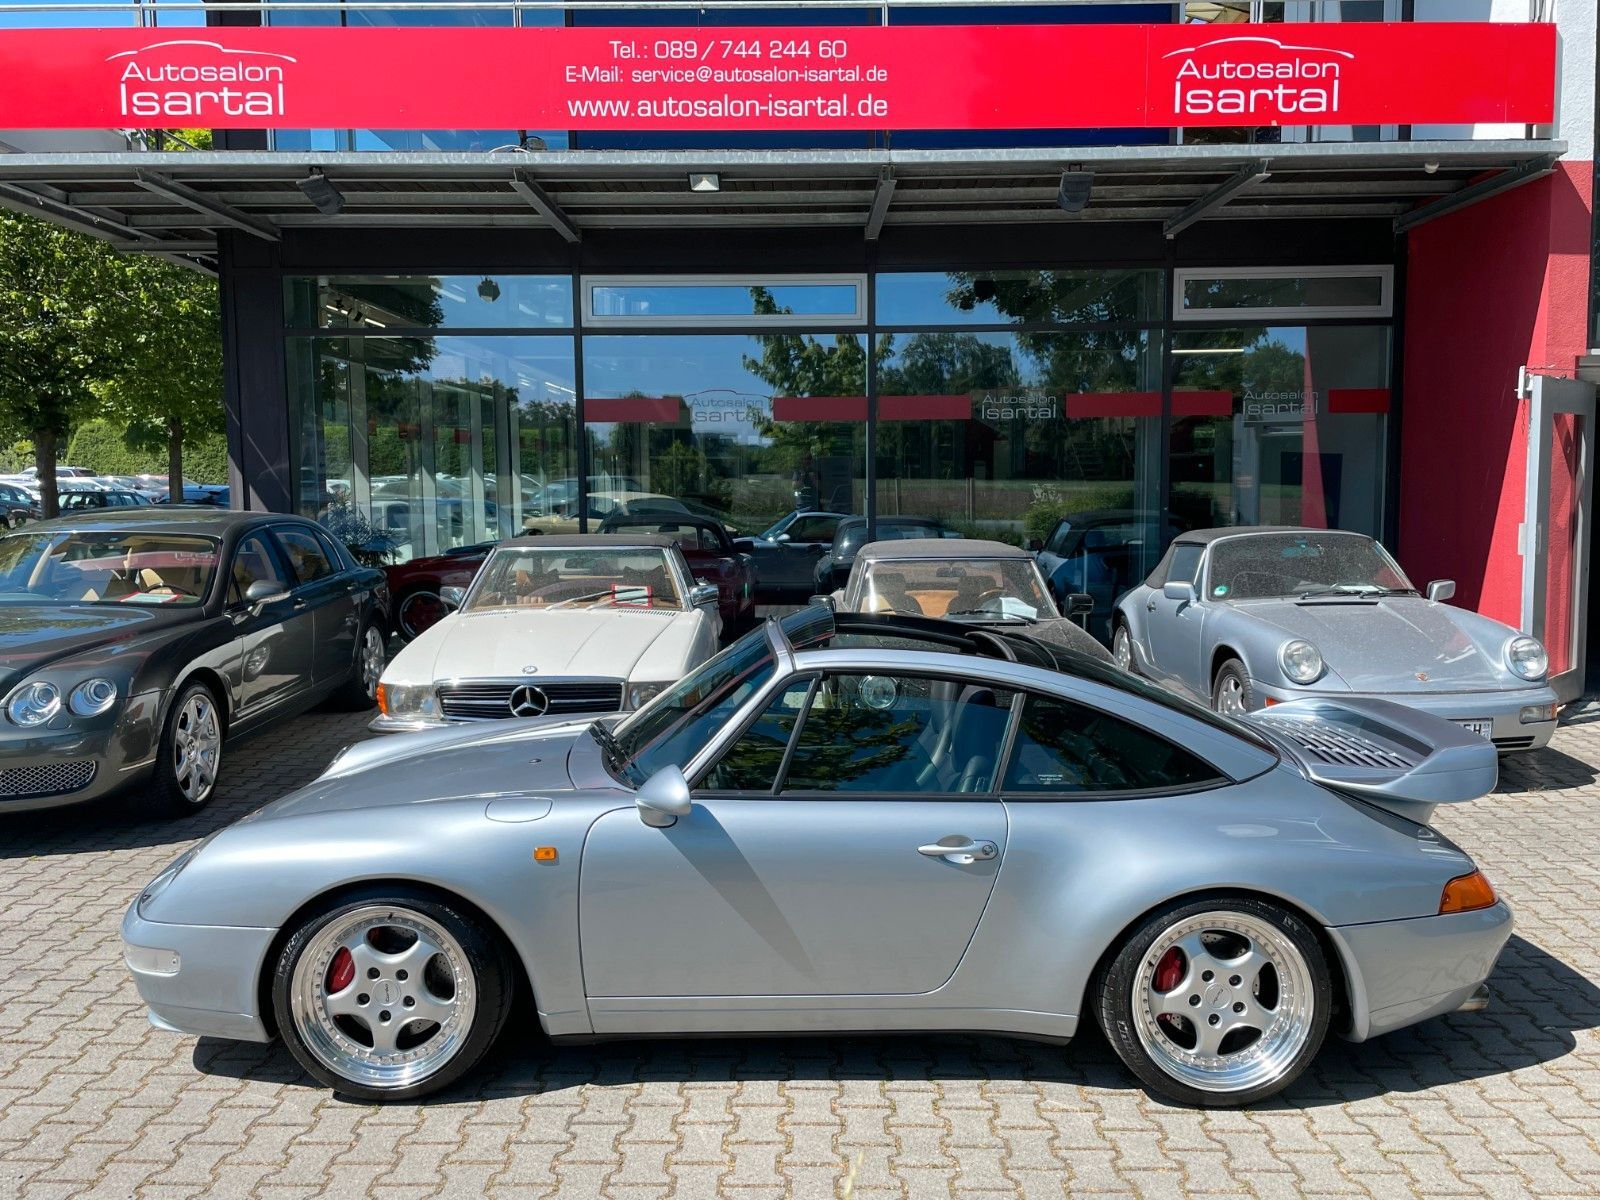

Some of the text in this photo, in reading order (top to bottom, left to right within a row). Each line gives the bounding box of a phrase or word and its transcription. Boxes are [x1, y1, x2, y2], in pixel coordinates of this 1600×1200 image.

[609, 40, 648, 59] Tel.:
[719, 40, 762, 59] 744
[769, 40, 812, 59] 244
[818, 40, 847, 59] 60
[121, 60, 284, 82] Autosalon
[565, 65, 888, 83] E-Mail: service@autosalon-isartal.de
[1176, 57, 1340, 80] Autosalon
[120, 82, 285, 116] Isartal
[567, 93, 888, 118] www.autosalon-isartal.de
[1174, 79, 1339, 114] Isartal
[691, 397, 764, 408] Autosalon
[982, 394, 1057, 404] Autosalon
[1243, 389, 1319, 400] Autosalon
[981, 403, 1056, 419] Isartal
[1242, 400, 1318, 415] Isartal
